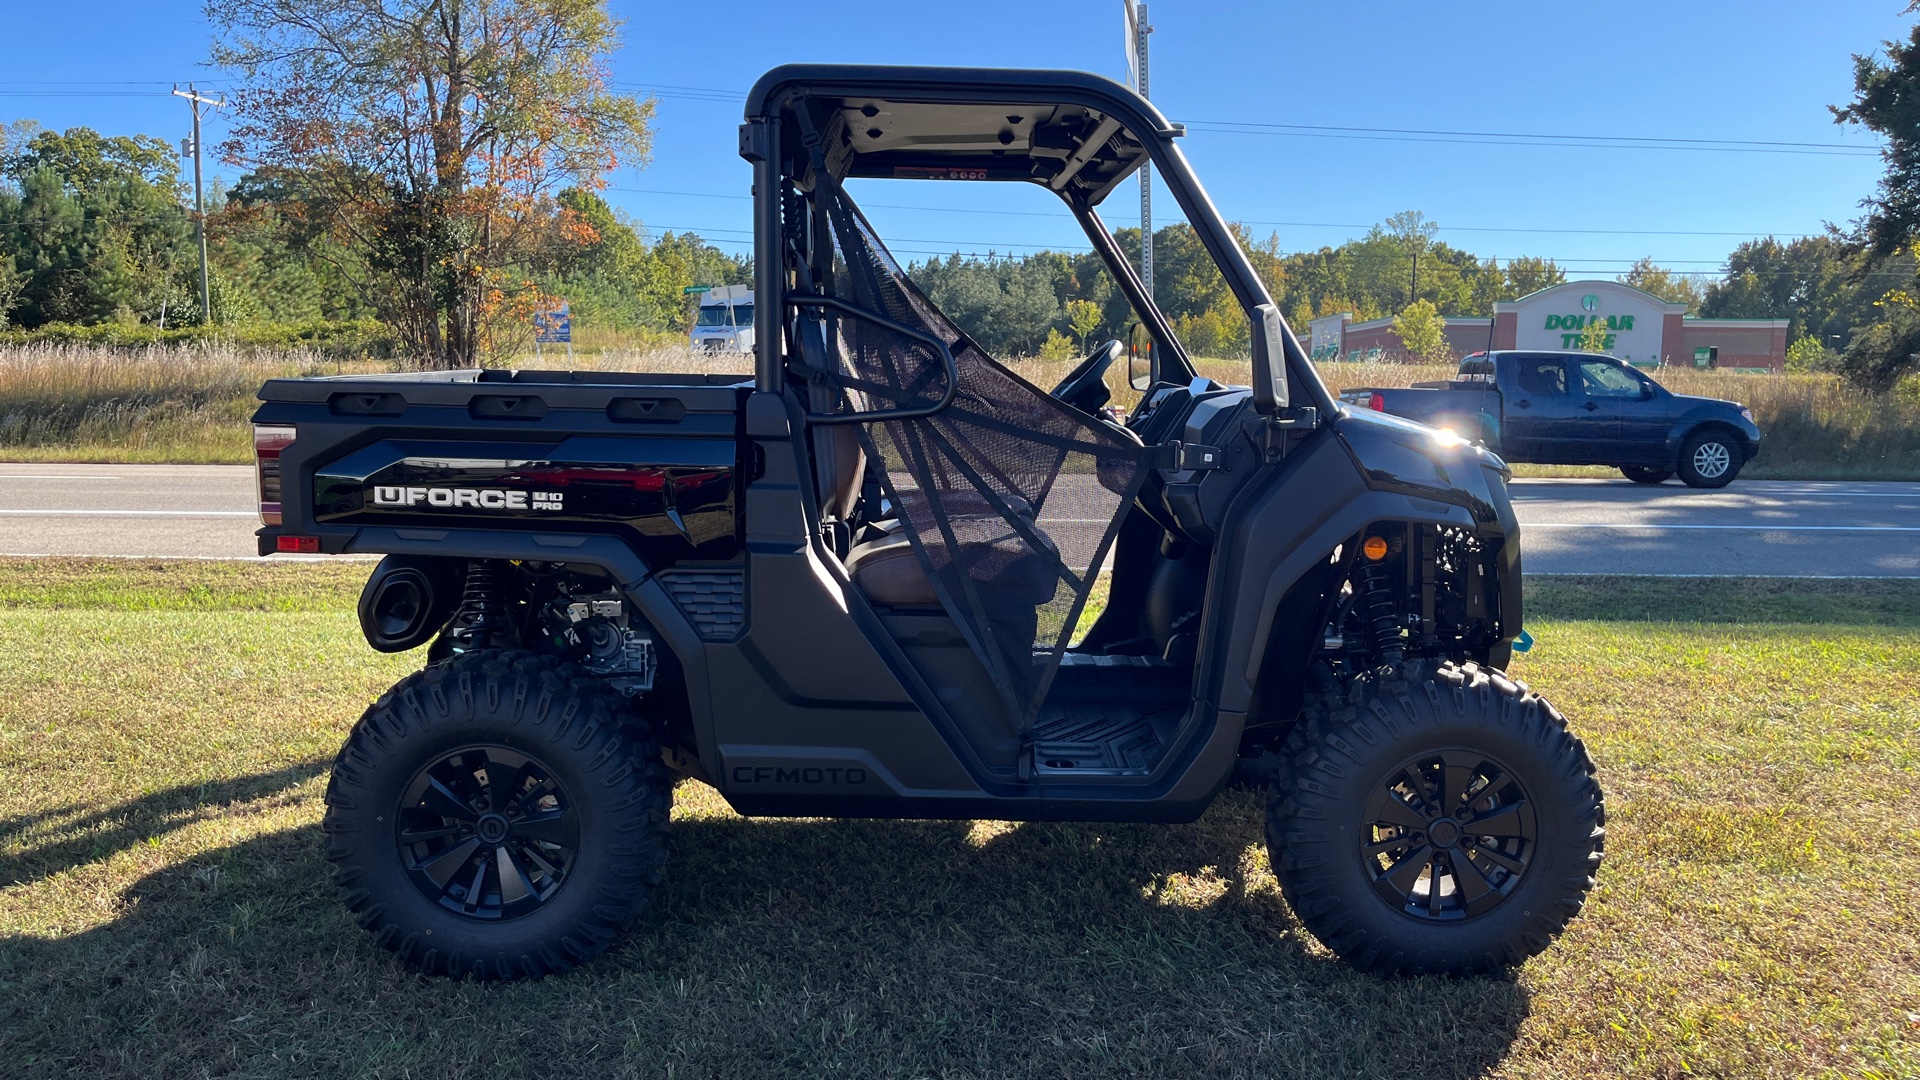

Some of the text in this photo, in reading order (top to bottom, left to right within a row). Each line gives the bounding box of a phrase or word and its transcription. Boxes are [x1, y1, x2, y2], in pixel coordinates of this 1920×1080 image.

[1544, 314, 1635, 331] DOLLAR
[532, 501, 563, 511] PRO
[732, 766, 867, 784] CFMOTO
